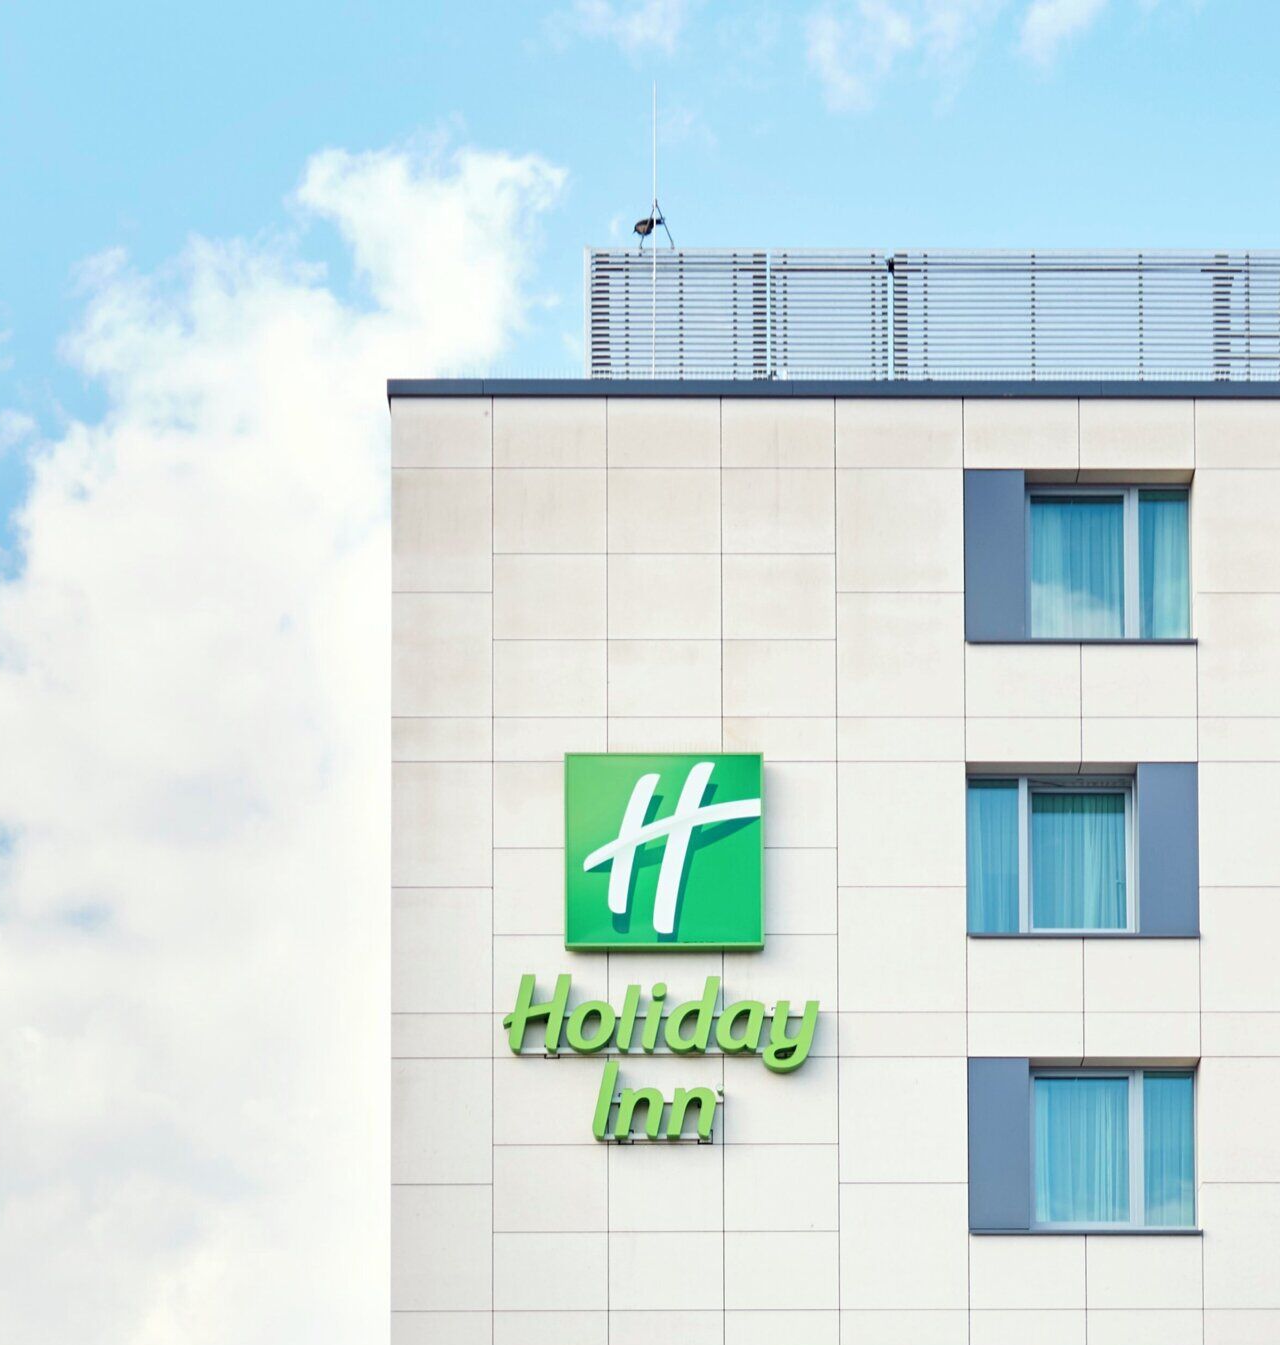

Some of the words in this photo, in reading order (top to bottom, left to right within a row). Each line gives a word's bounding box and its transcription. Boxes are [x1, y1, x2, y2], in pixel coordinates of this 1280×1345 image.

[583, 762, 761, 933] H
[503, 974, 820, 1074] Holiday
[592, 1061, 717, 1141] Inn
